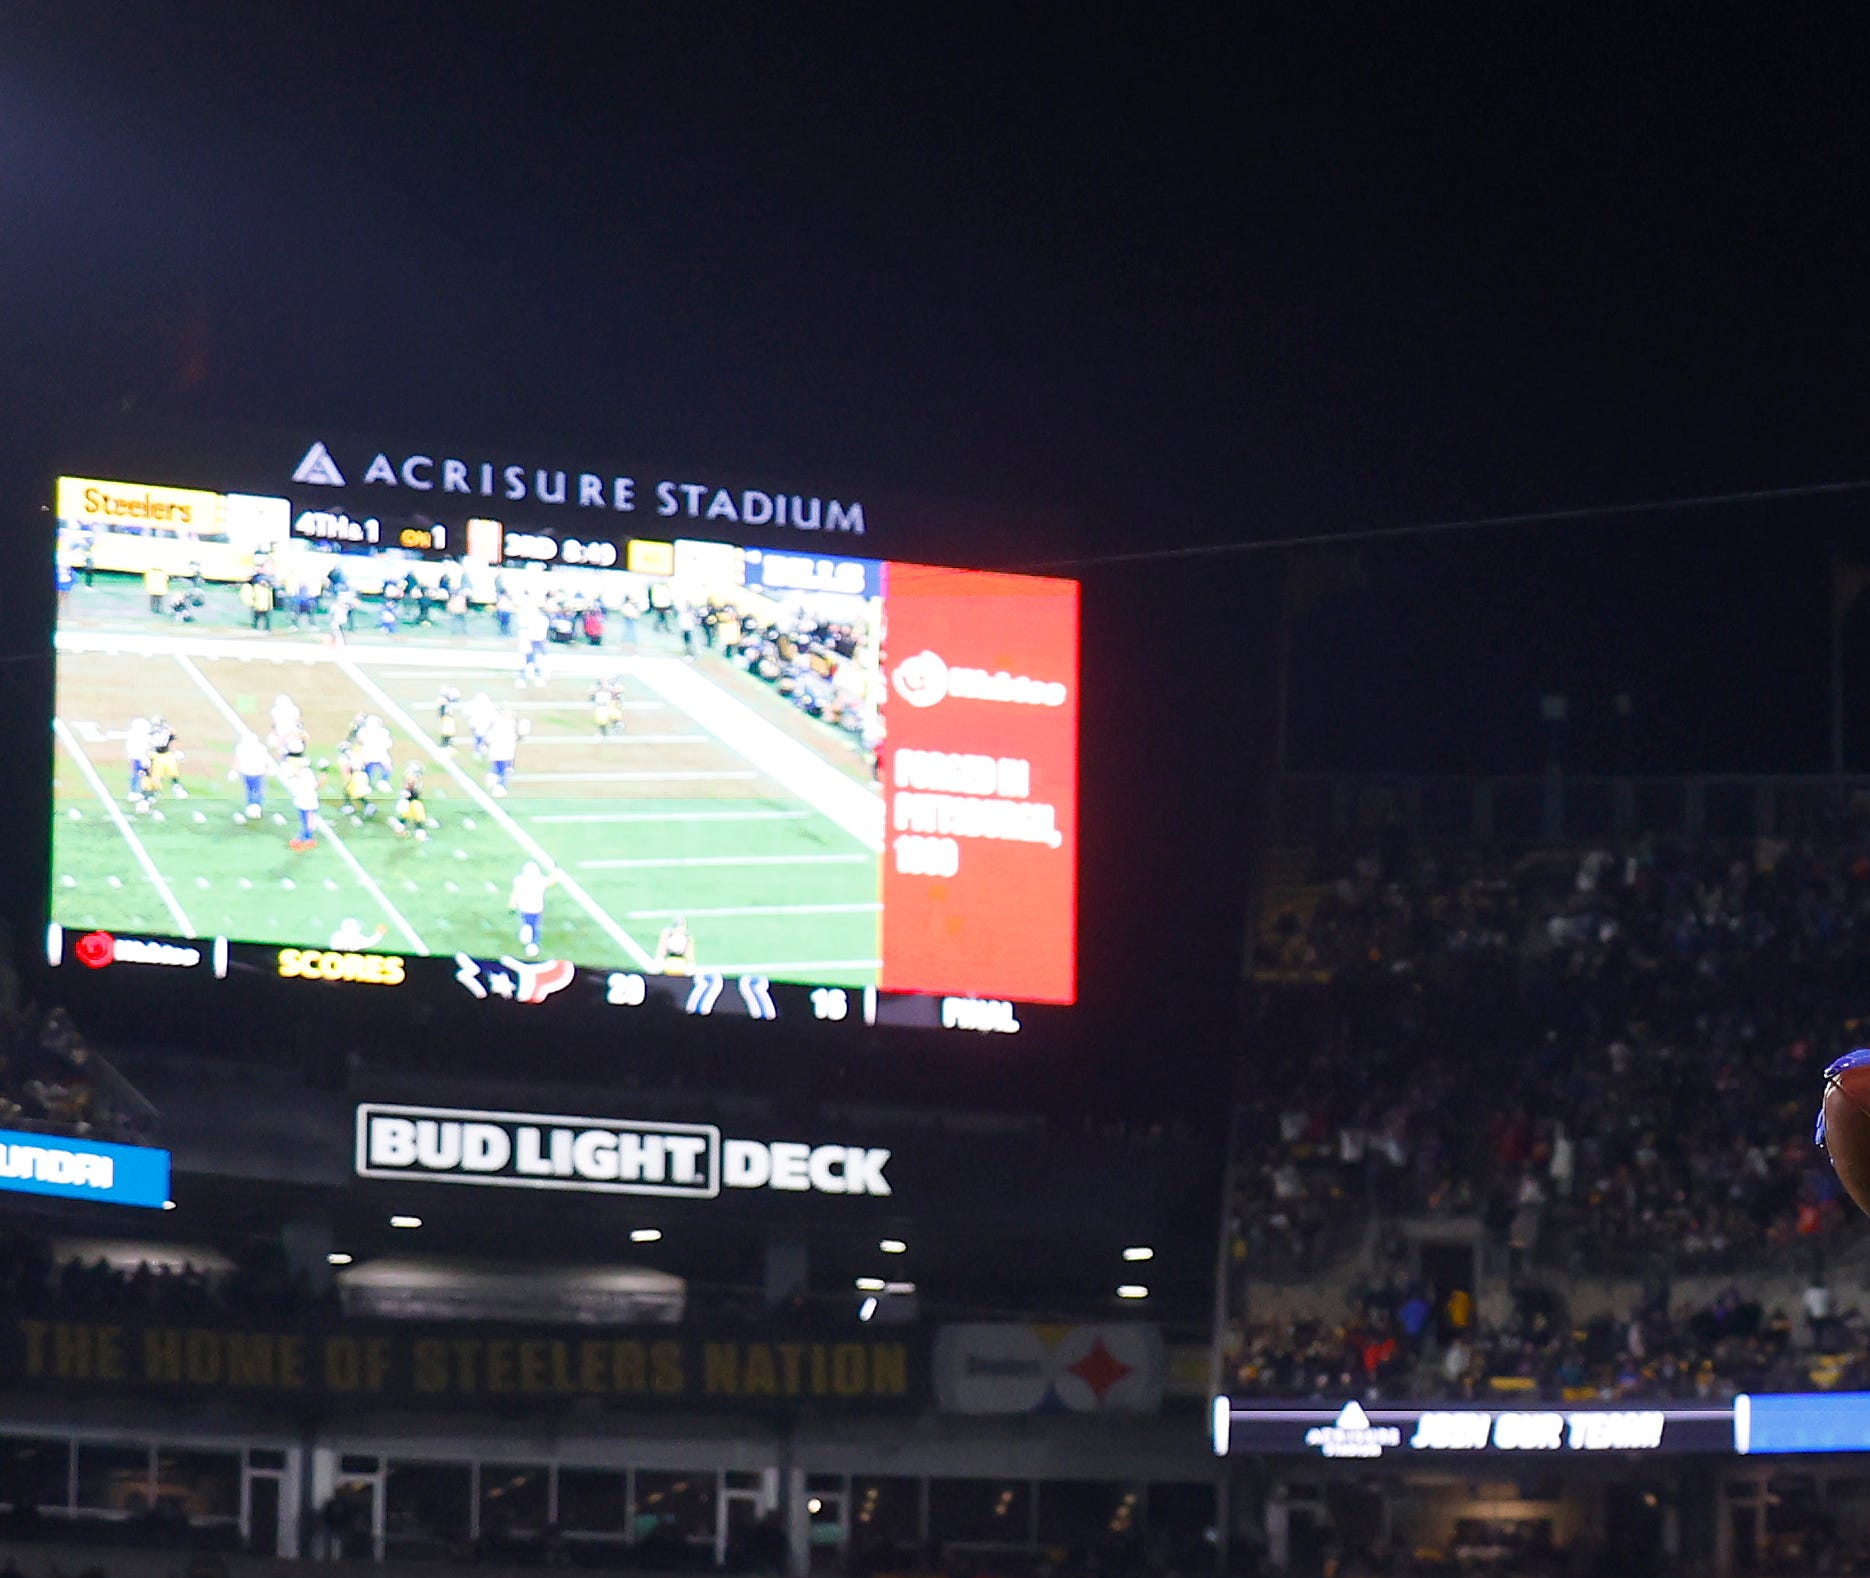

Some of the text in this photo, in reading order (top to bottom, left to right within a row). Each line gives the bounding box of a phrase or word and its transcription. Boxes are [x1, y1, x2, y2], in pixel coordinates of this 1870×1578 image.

[84, 487, 192, 523] Steelers
[364, 452, 867, 535] ACRISURE STADIUM
[277, 947, 406, 986] SCORES
[0, 1142, 114, 1190] UNDAI
[369, 1116, 892, 1197] BUD LIGHT DECK
[20, 1320, 125, 1384] THE
[144, 1327, 306, 1389] HOME
[322, 1333, 393, 1392] OF
[411, 1335, 686, 1396] STEELERS
[703, 1341, 910, 1396] NATION
